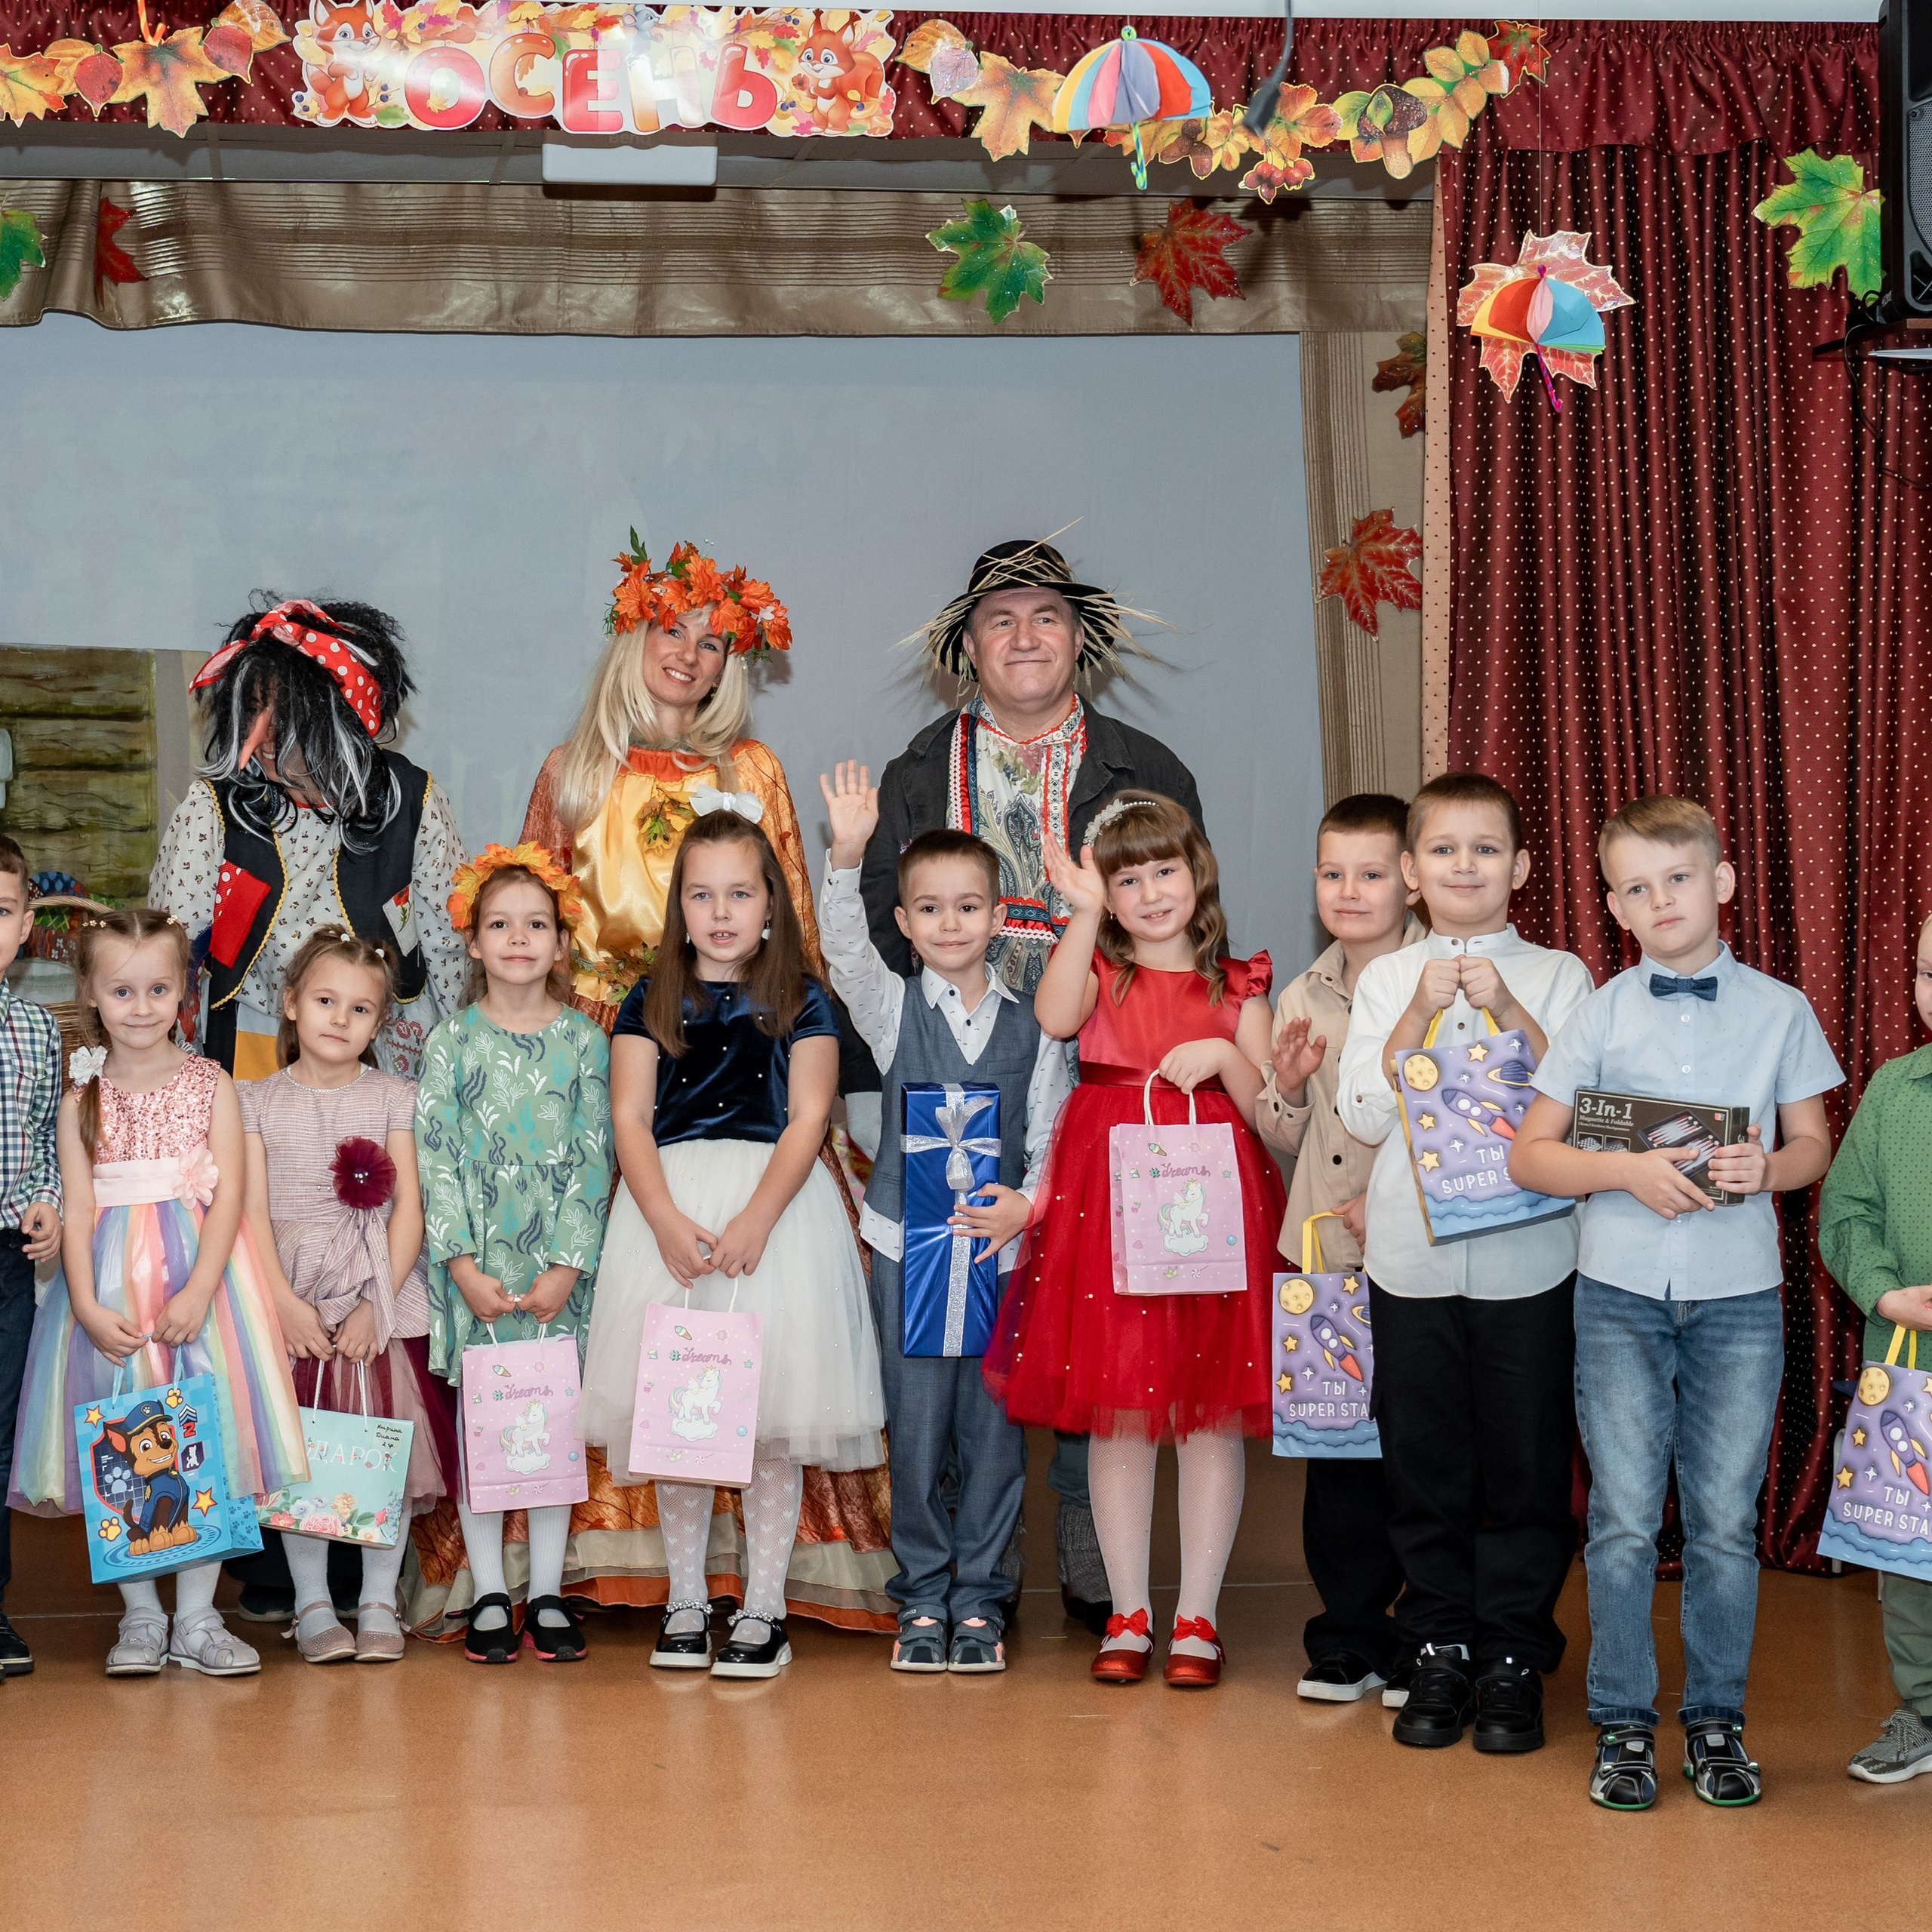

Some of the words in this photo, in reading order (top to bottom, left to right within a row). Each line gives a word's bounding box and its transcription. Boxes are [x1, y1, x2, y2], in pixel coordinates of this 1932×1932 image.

[405, 32, 778, 132] ОСЕНЬ
[1579, 1097, 1632, 1119] 3-In-1
[1579, 1115, 1604, 1124] Magnetic
[1475, 1144, 1506, 1164] ТЫ
[1441, 1170, 1499, 1194] SUPER
[1322, 1381, 1346, 1395] ТЫ
[1289, 1403, 1335, 1417] SUPER
[1340, 1403, 1368, 1417] STA
[304, 1438, 398, 1472] ДАРОК
[1884, 1486, 1910, 1506] ТЫ
[1843, 1502, 1894, 1527] SUPER
[1899, 1514, 1932, 1535] STA
